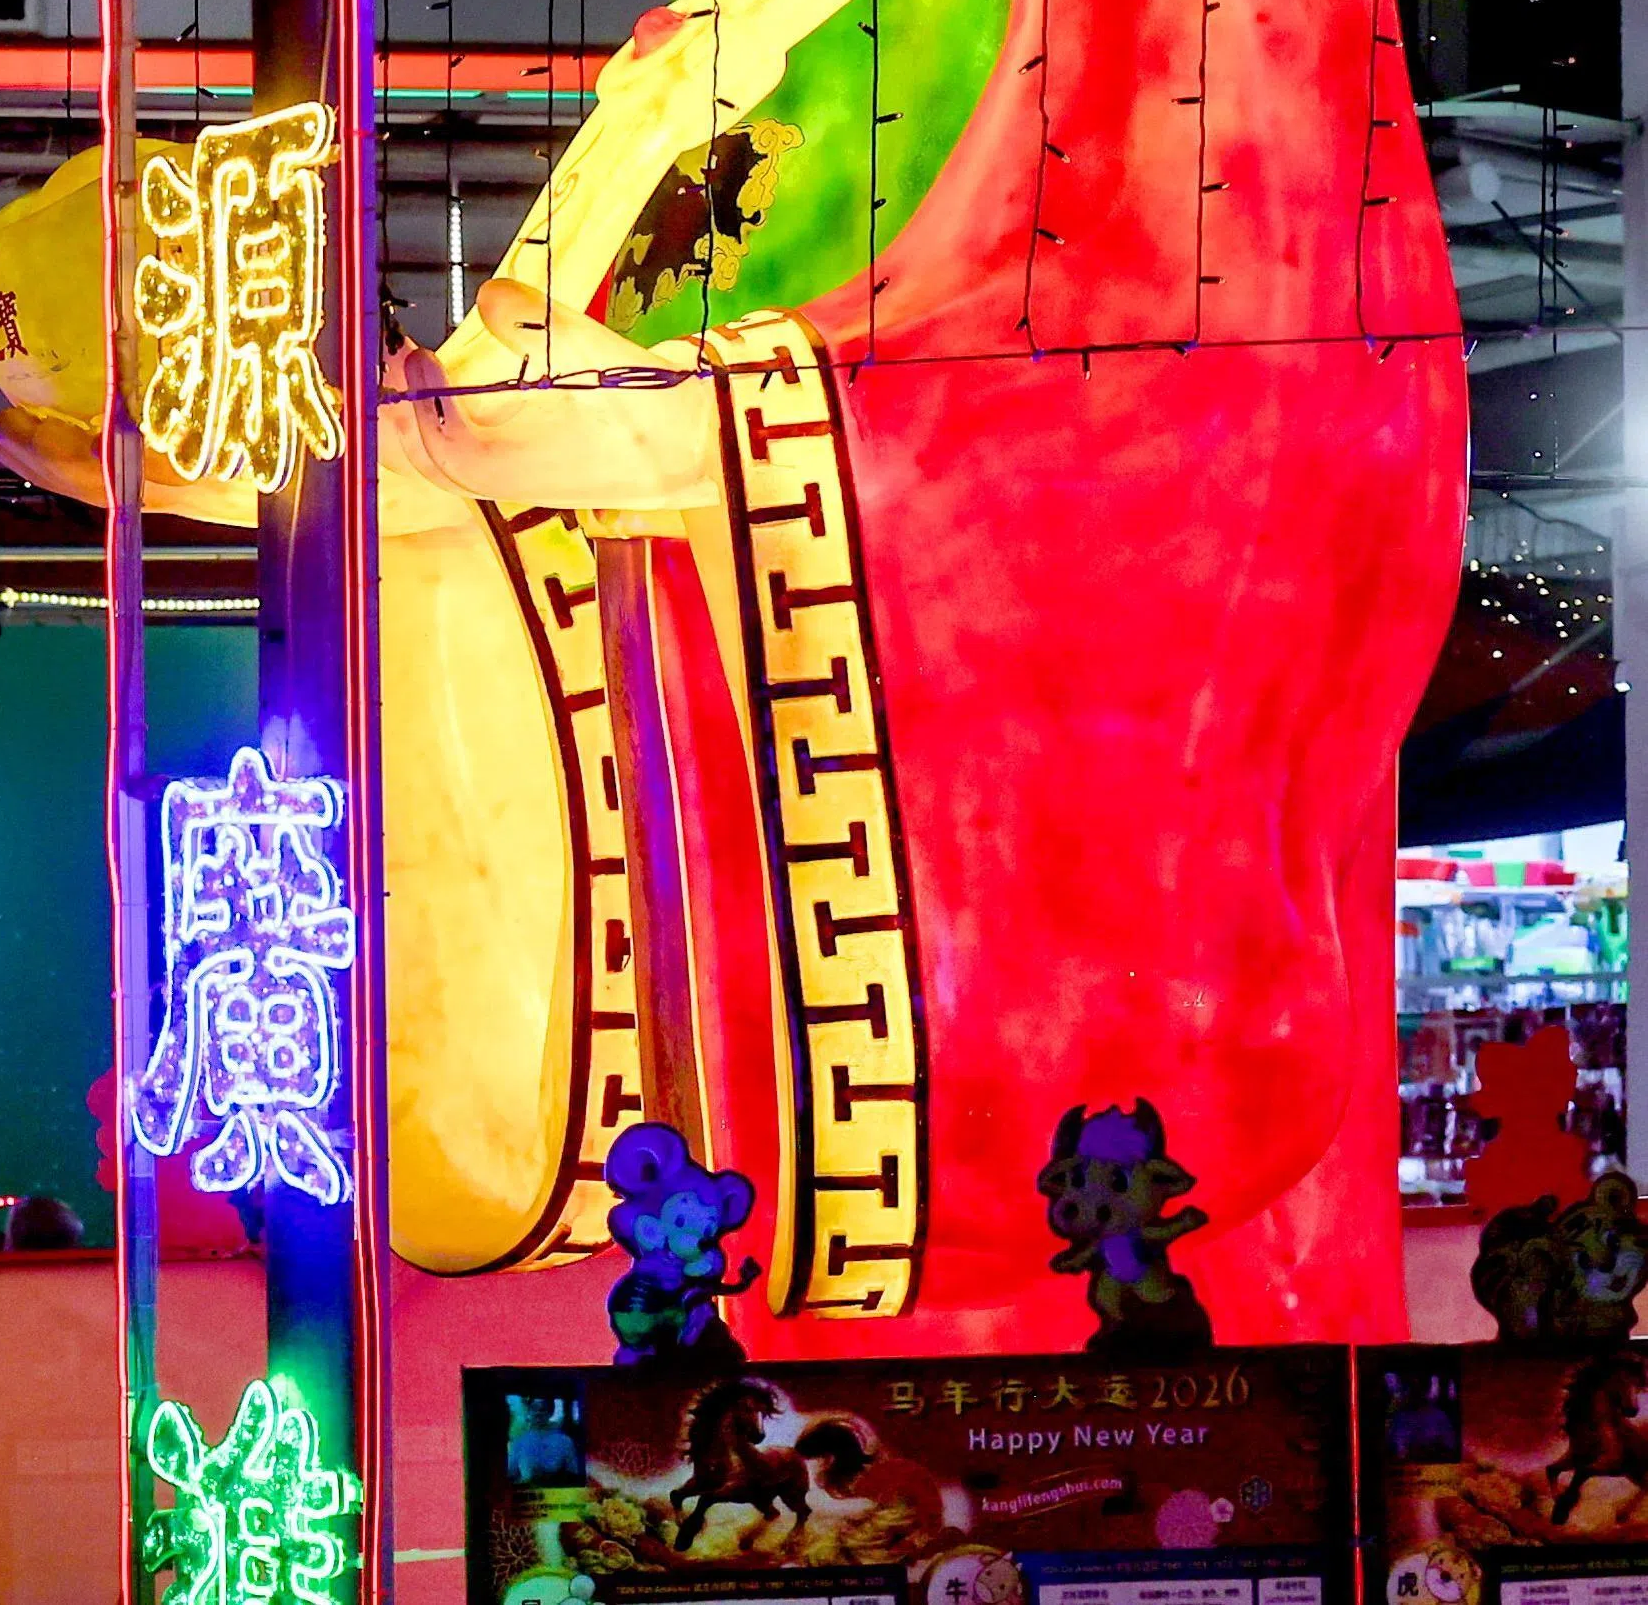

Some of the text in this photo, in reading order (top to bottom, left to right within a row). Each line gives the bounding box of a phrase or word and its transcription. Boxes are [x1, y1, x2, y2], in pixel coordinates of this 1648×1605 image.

[882, 1364, 1250, 1416] 马年行大运 2026
[968, 1422, 1209, 1454] Happy New Year
[945, 1577, 968, 1604] 牛
